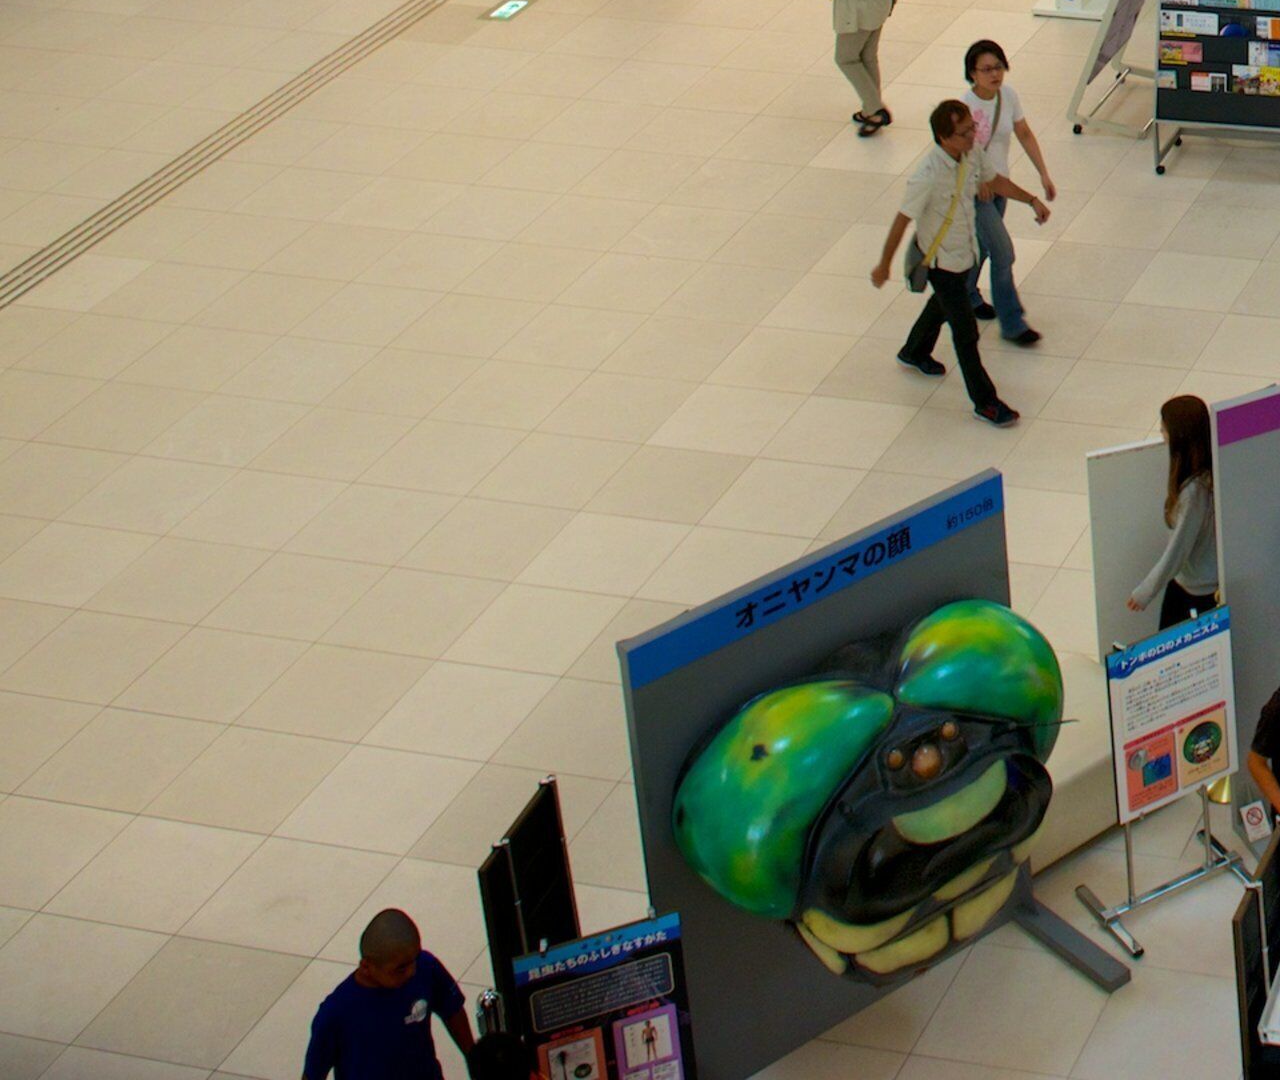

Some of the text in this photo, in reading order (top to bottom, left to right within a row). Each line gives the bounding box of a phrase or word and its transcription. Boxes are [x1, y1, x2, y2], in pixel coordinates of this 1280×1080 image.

[735, 525, 912, 630] オニヤンマの顔
[1120, 622, 1220, 671] トンボの口のメカニズム
